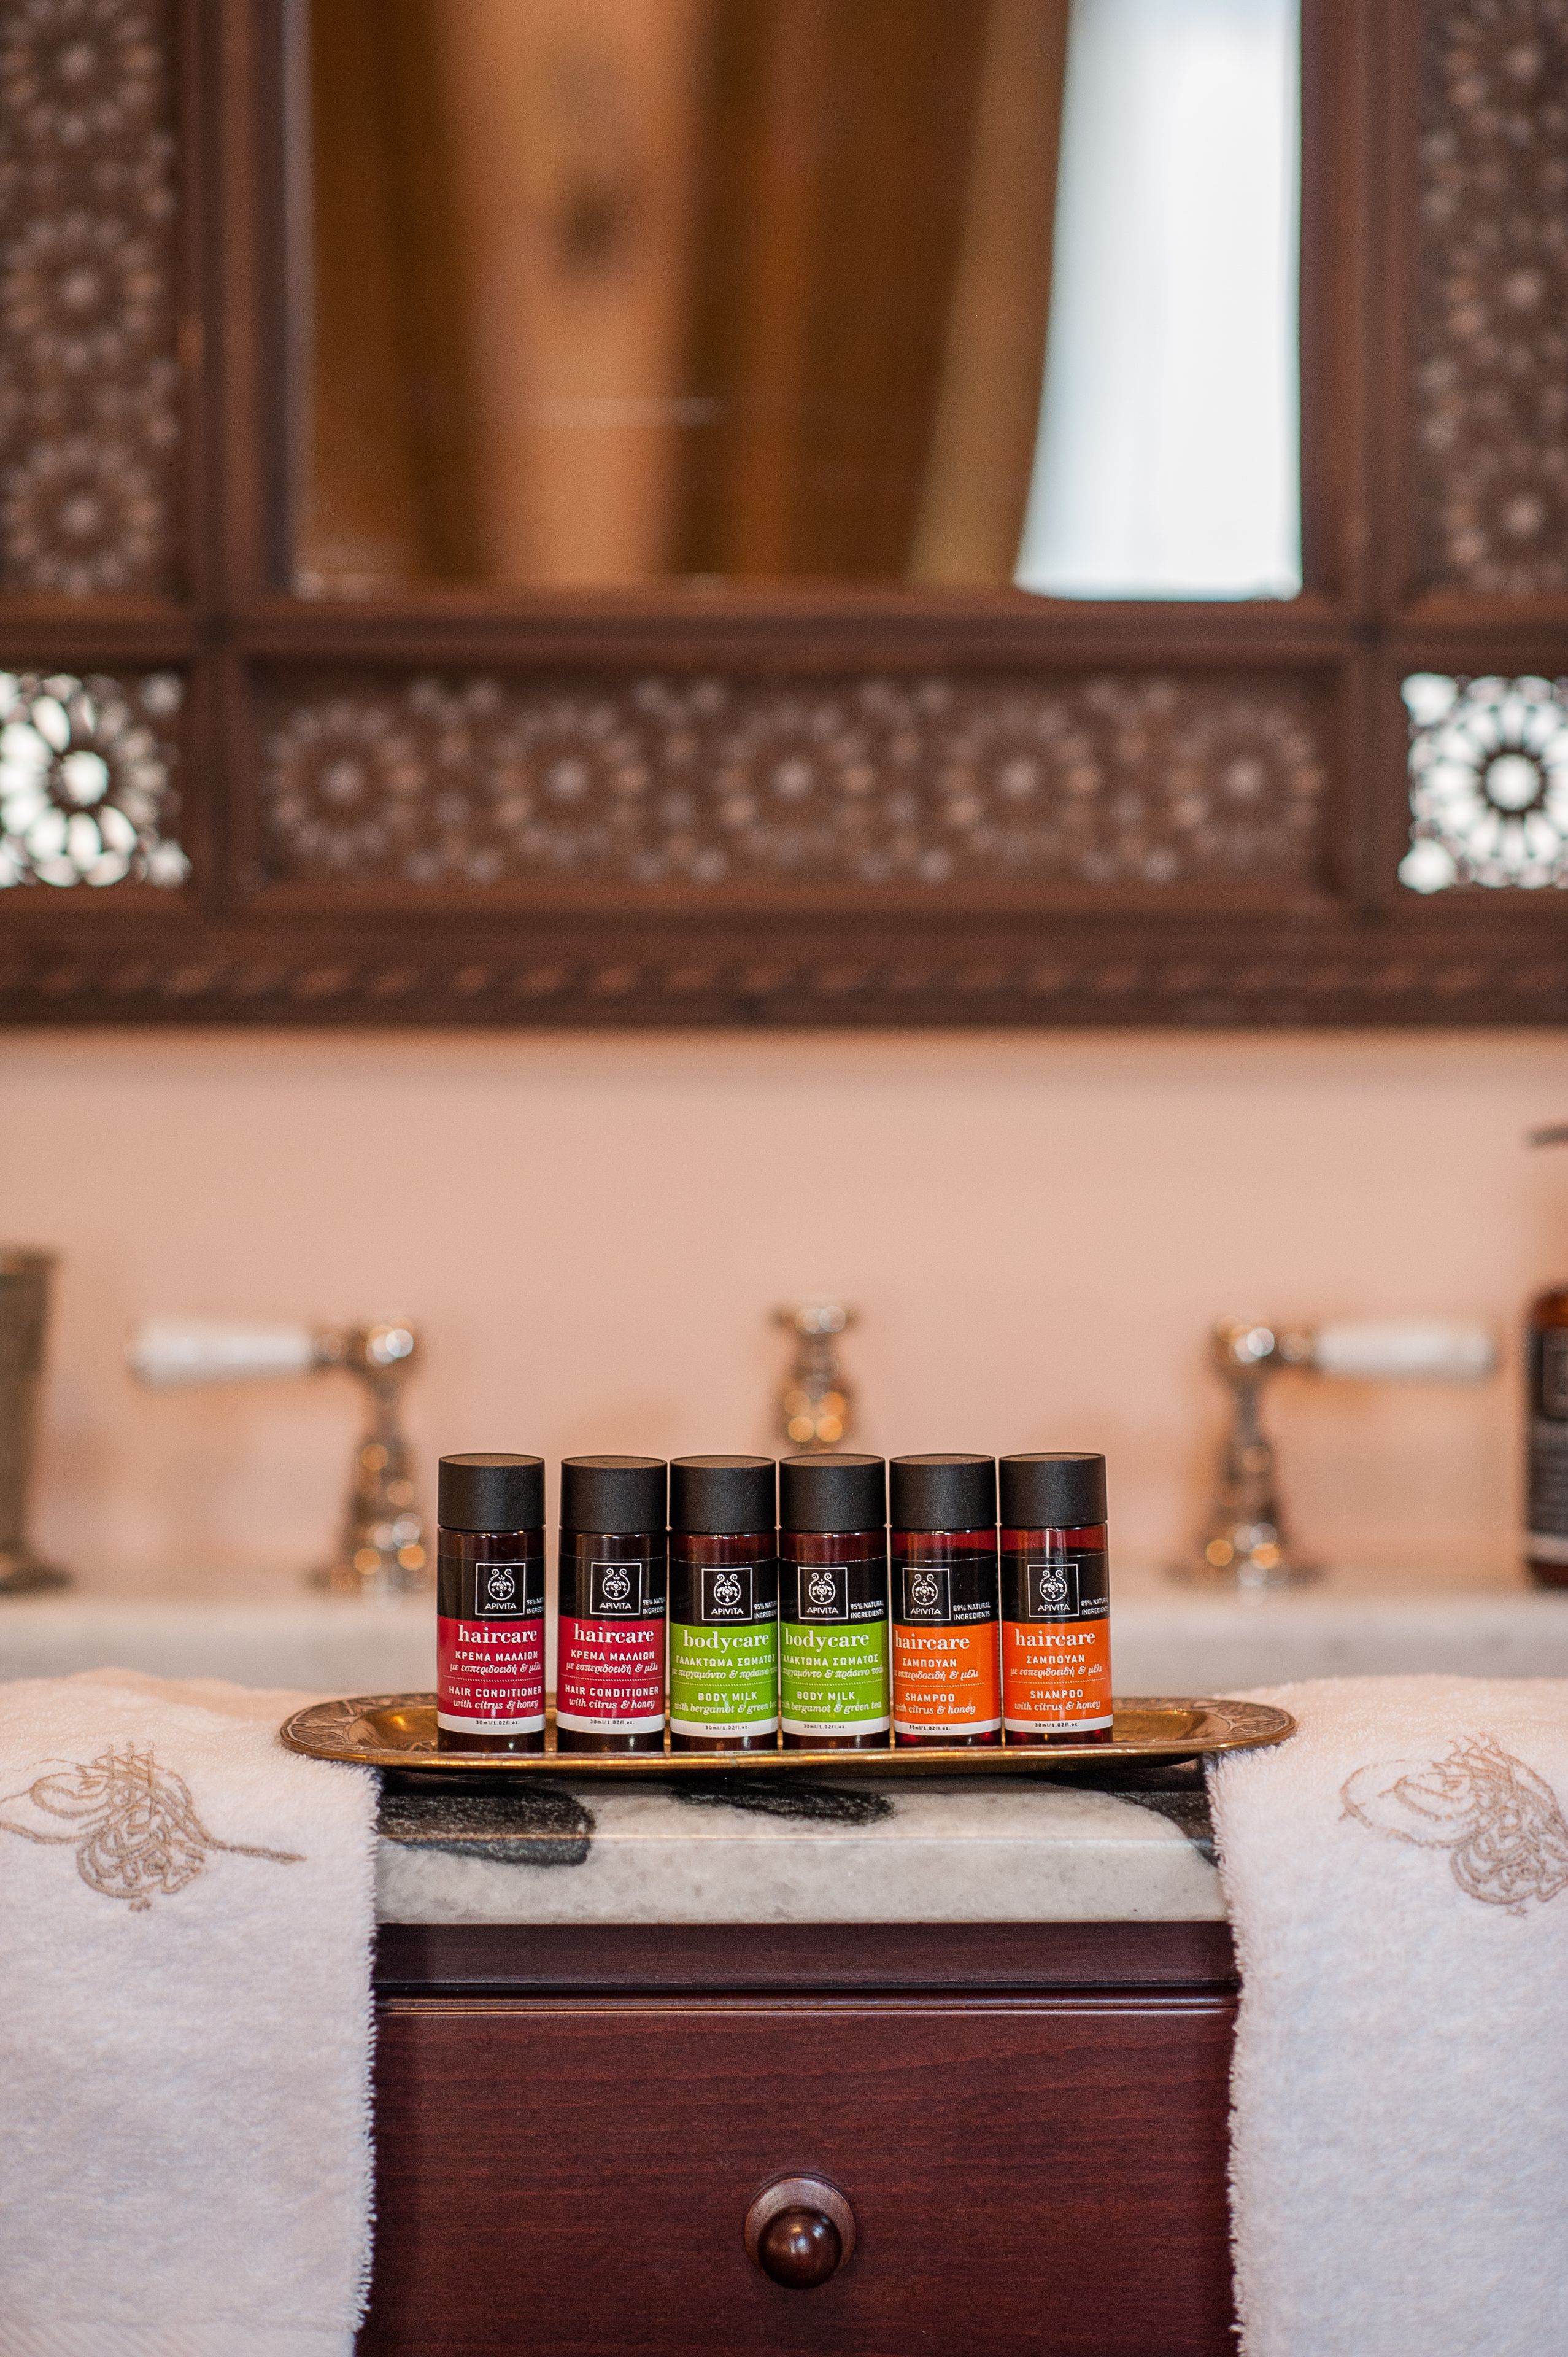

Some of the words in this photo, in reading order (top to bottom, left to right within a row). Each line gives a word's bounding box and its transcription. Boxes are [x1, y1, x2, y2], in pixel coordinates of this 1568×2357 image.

[863, 1600, 884, 1609] NATURAL
[967, 1601, 991, 1610] NATURAL
[851, 1609, 884, 1619] INGREDIENTS
[953, 1611, 991, 1620] INGREDIENTS
[458, 1624, 537, 1644] haircare
[573, 1624, 654, 1643] haircare
[1015, 1628, 1095, 1647] haircare
[683, 1630, 769, 1653] bodycare
[785, 1628, 869, 1652] bodycare
[895, 1631, 970, 1651] haircare
[455, 1651, 490, 1661] ΚΡΕΜΑ
[496, 1651, 538, 1661] ΜΑΛΛΙΩΝ
[571, 1649, 604, 1661] ΚΡΕΜΑ
[610, 1650, 655, 1661] ΜΑΛΛΙΩΝ
[676, 1655, 733, 1666] ΓΑΛΑΚΤΩΜΑ
[738, 1655, 775, 1666] ΣΩΜΑΤΟΣ
[833, 1654, 879, 1666] ΣΩΜΑΤΟΣ
[1026, 1654, 1085, 1664] ΣΑΜΠΟΥΑΝ
[902, 1658, 957, 1668] ΣΑΜΠΟΥΑΝ
[960, 1670, 979, 1681] μέλι
[449, 1686, 471, 1696] HAIR
[476, 1686, 541, 1697] CONDITIONER
[565, 1684, 585, 1695] HAIR
[590, 1686, 658, 1697] CONDITIONER
[797, 1691, 823, 1700] BODY
[828, 1691, 855, 1700] MILK
[1030, 1689, 1083, 1699] SHAMPOO
[698, 1693, 727, 1701] BODY
[732, 1692, 757, 1701] MILK
[905, 1693, 955, 1702] SHAMPOO
[454, 1699, 472, 1708] with
[475, 1700, 503, 1710] citrus
[506, 1701, 515, 1709] &
[517, 1700, 538, 1710] honey
[568, 1698, 587, 1708] with
[589, 1700, 617, 1709] citrus
[620, 1701, 630, 1709] &
[631, 1699, 655, 1709] honey
[674, 1702, 689, 1711] with
[690, 1703, 735, 1714] bergamot
[747, 1703, 768, 1715] green
[791, 1701, 831, 1713] bergamot
[844, 1702, 869, 1714] green
[871, 1701, 881, 1710] tea
[1014, 1701, 1032, 1711] with
[1034, 1701, 1063, 1711] citrus
[1065, 1702, 1075, 1711] &
[1076, 1700, 1100, 1711] honey
[908, 1704, 934, 1714] citrus
[936, 1706, 946, 1714] &
[948, 1704, 976, 1715] honey
